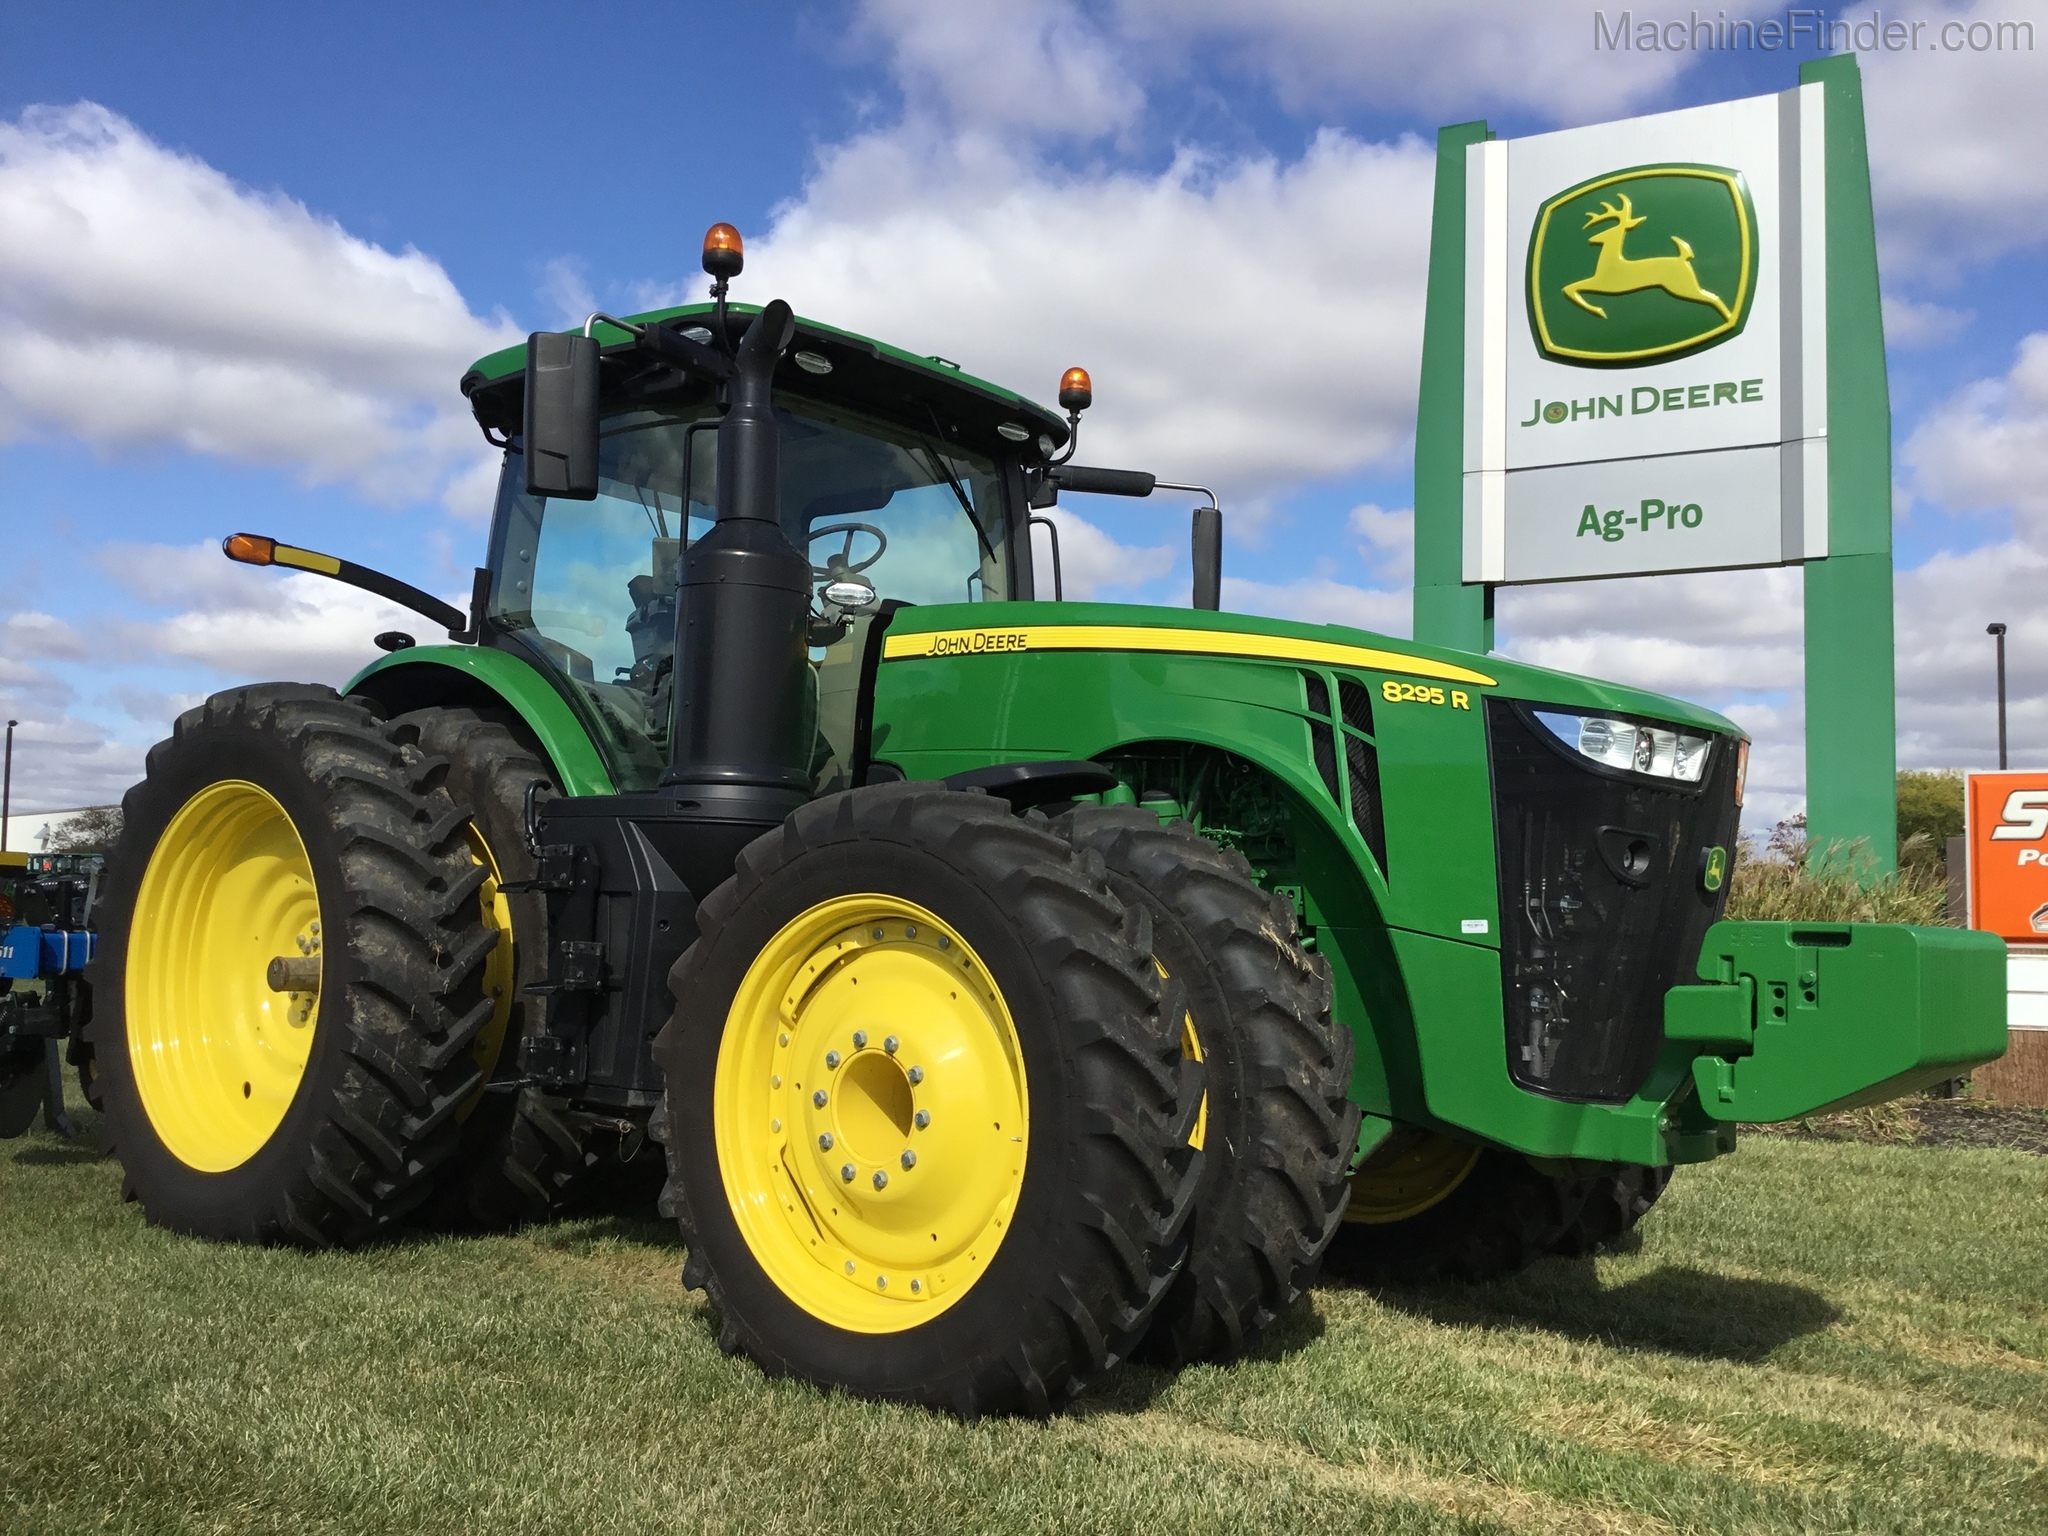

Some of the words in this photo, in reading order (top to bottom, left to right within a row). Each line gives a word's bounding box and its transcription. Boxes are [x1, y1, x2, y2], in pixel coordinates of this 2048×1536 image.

[1521, 395, 1622, 427] JOHN
[1631, 378, 1763, 415] DEERE
[1577, 498, 1703, 542] Ag-Pro
[928, 634, 971, 655] JOHN
[973, 632, 1028, 652] DEERE
[1382, 680, 1446, 706] 8295
[1450, 689, 1470, 711] R
